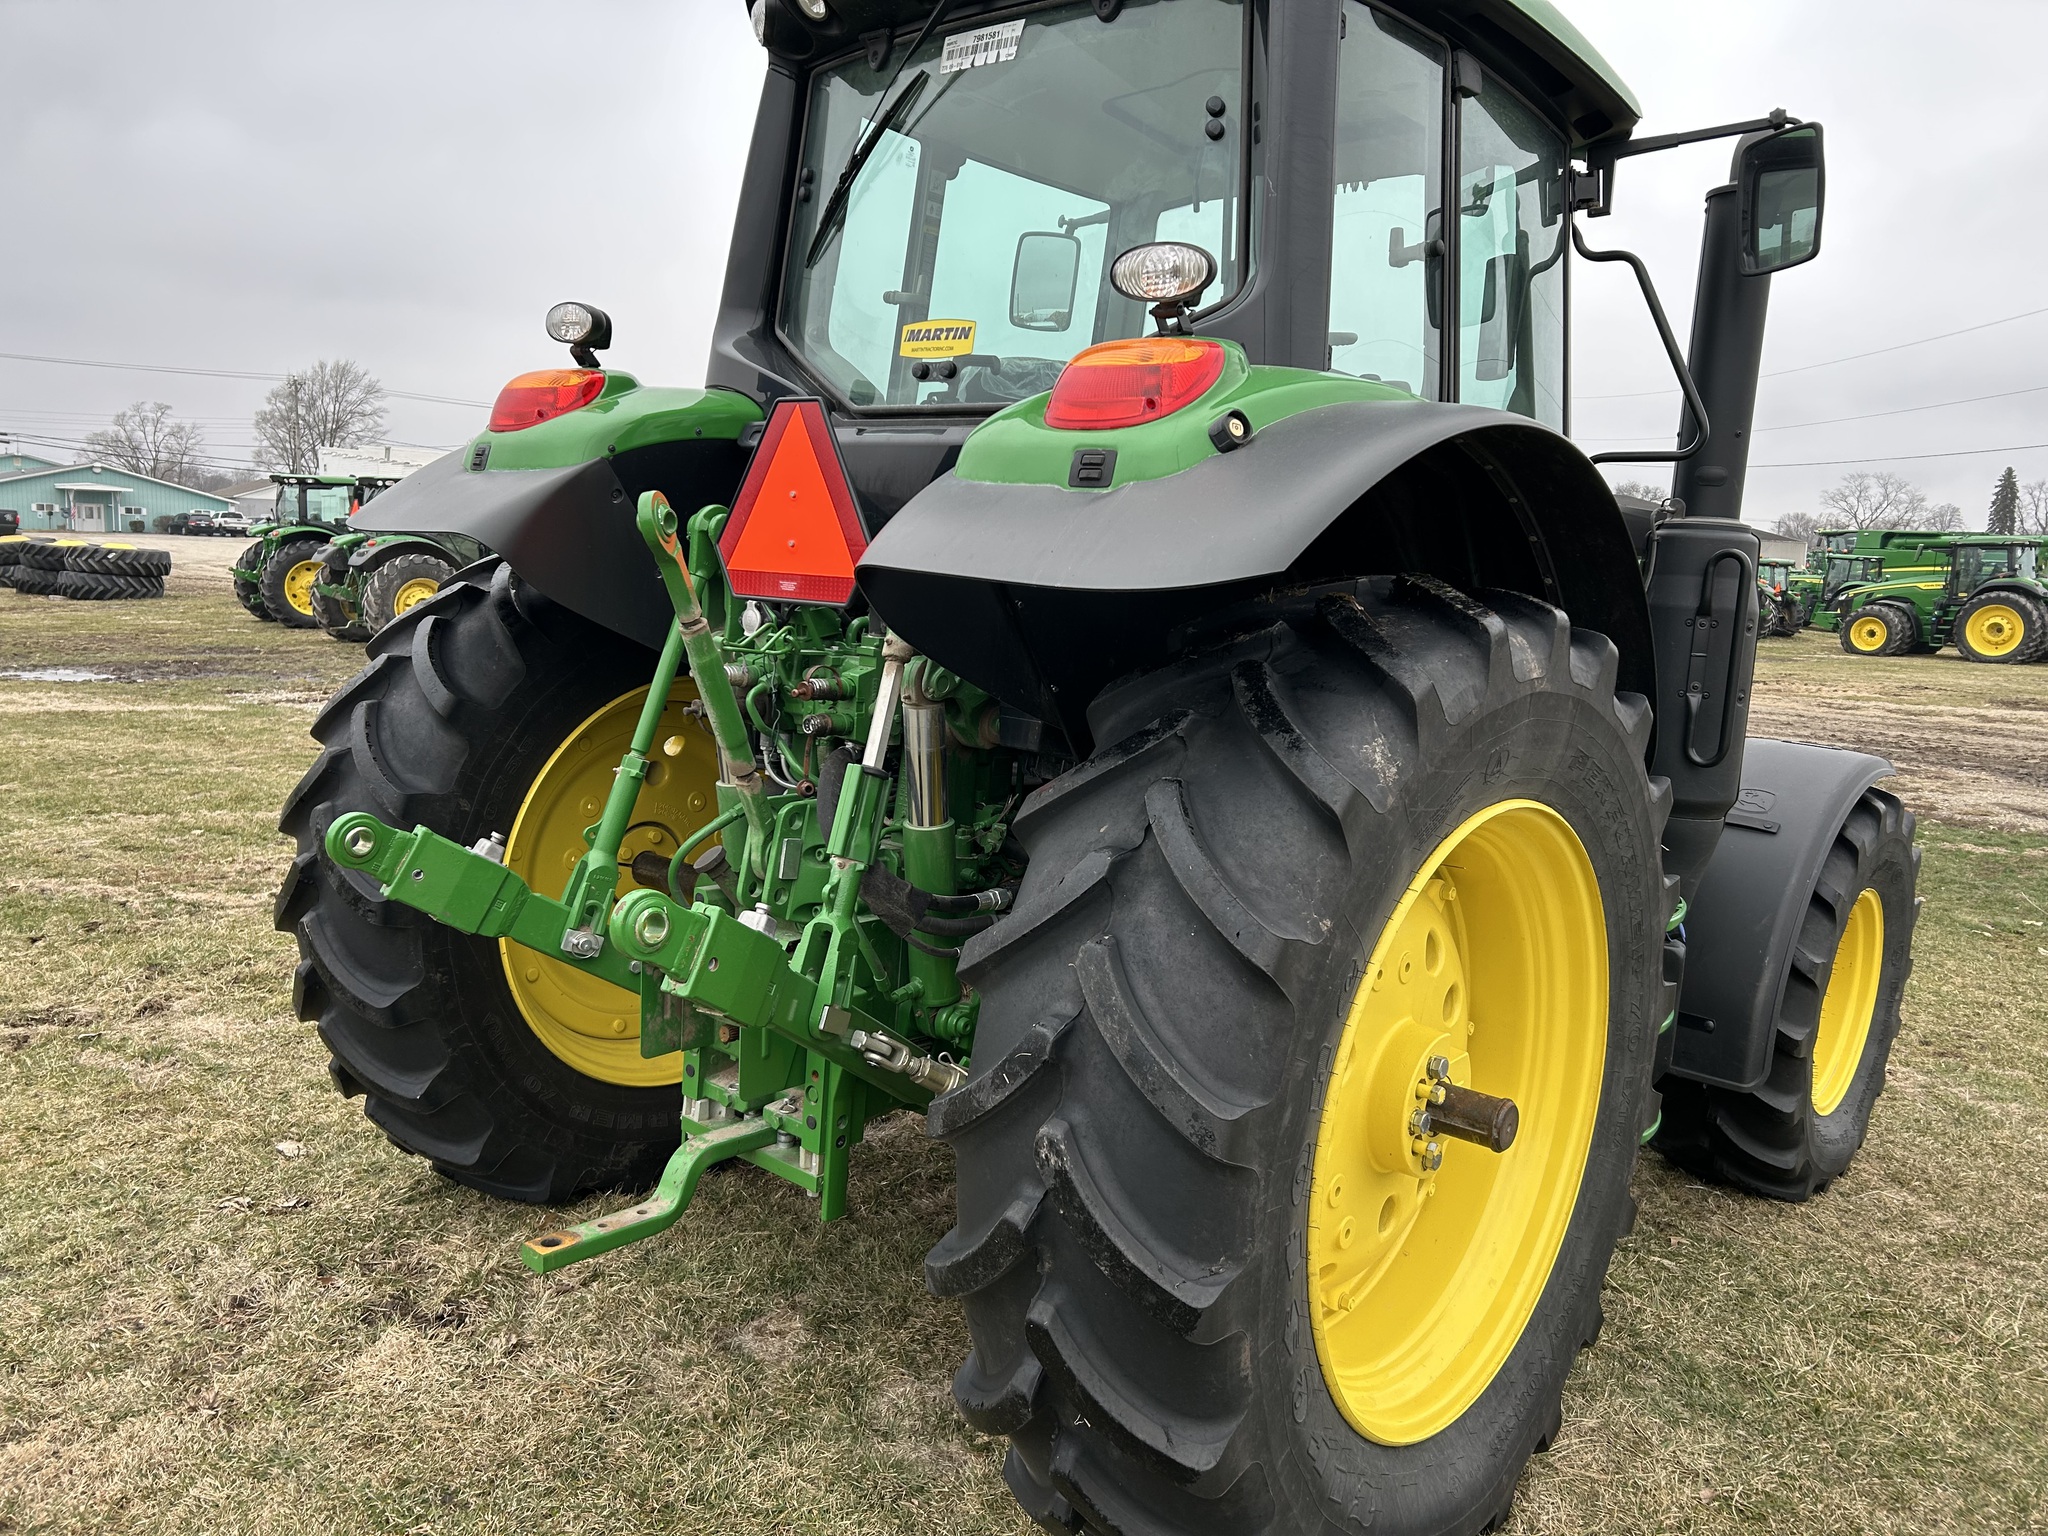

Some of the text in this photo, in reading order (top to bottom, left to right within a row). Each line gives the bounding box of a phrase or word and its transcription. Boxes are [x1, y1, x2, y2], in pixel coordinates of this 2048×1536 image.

[973, 30, 1000, 43] 7981581
[905, 327, 972, 342] MARTIN
[1610, 1073, 1634, 1152] EXTRA
